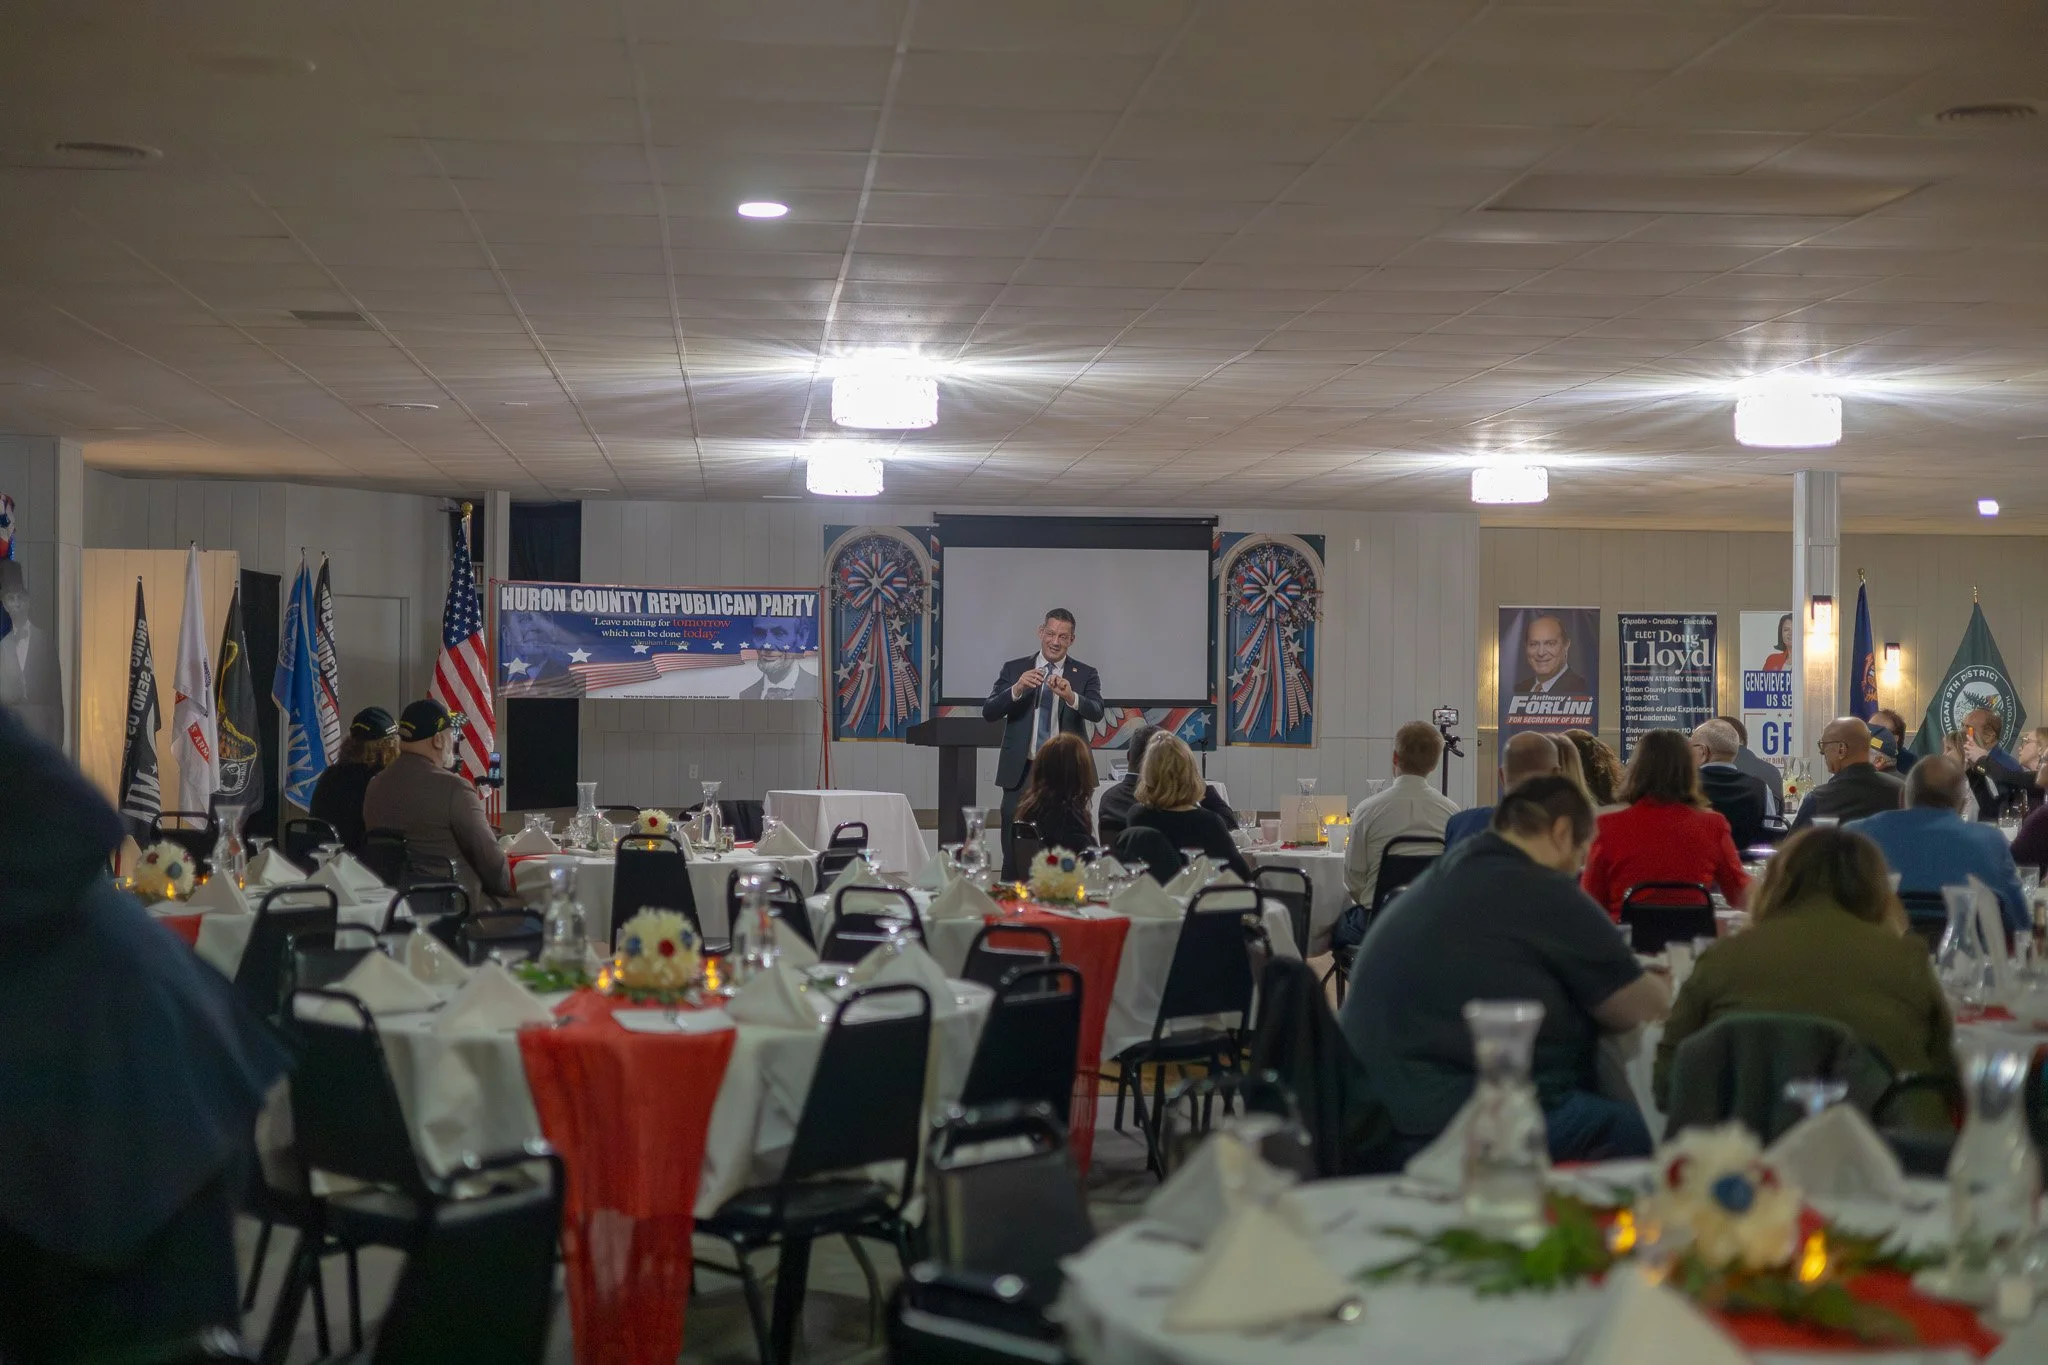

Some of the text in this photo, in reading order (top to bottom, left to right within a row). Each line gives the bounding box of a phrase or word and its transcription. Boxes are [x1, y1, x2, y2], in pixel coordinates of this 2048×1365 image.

[501, 587, 816, 616] HURON COUNTY REPUBLICAN PARTY
[622, 618, 656, 628] nothing
[658, 618, 670, 627] for
[672, 619, 732, 628] tomorrow
[1621, 617, 1647, 625] Capable
[1652, 617, 1678, 625] Credible
[601, 628, 629, 637] which
[630, 630, 646, 638] can
[648, 629, 658, 638] be
[660, 630, 681, 638] done
[1635, 630, 1699, 647] ELECT Doug
[1624, 638, 1711, 675] Lloyd
[1745, 672, 1784, 692] GENEVIEVE
[1946, 680, 1961, 698] 9TH
[1961, 669, 1998, 682] DISTRICT
[1531, 694, 1566, 702] Anthony
[1766, 694, 1792, 706] US SE
[1508, 696, 1594, 715] FORLINI
[1508, 716, 1591, 724] FOR SECRETARY OF STATE
